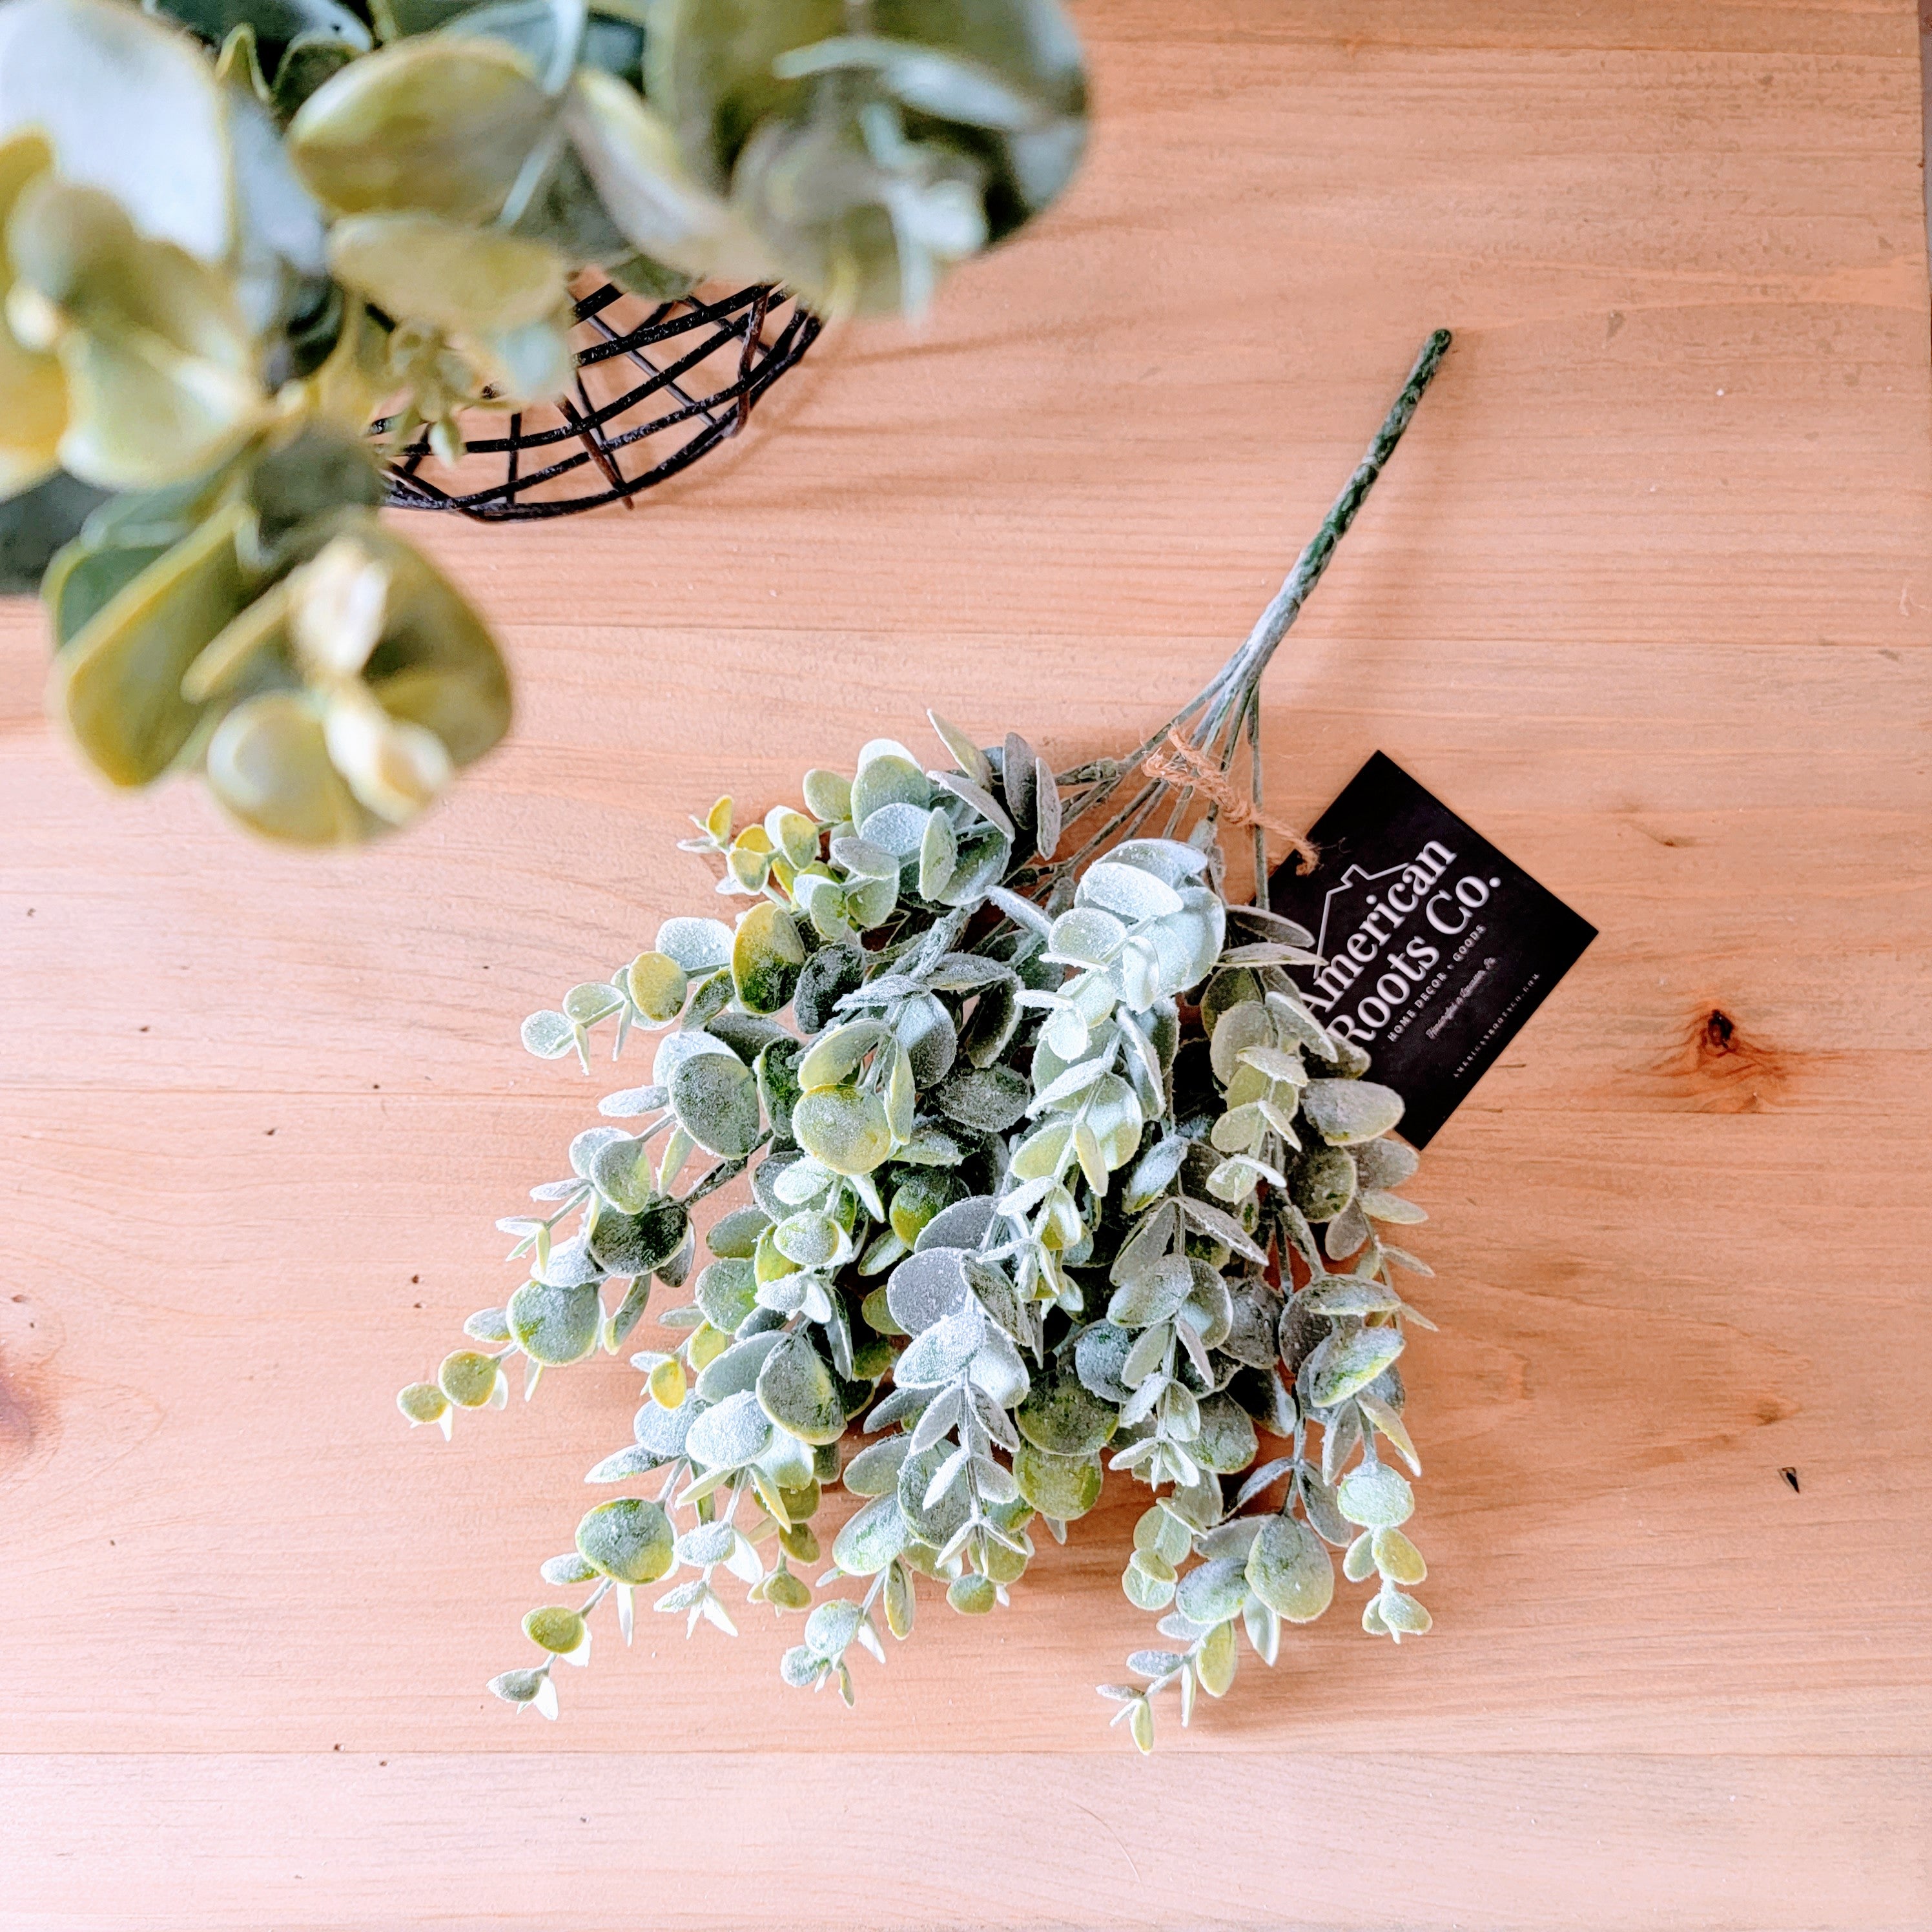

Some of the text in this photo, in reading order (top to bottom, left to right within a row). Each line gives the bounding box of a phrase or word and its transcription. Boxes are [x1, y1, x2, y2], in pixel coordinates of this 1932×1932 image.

[1299, 840, 1456, 1013] American
[1325, 876, 1500, 1040] Roots Co.
[1387, 1009, 1415, 1041] HOME
[1414, 972, 1446, 1008] DECOR
[1452, 925, 1485, 961] GOODS
